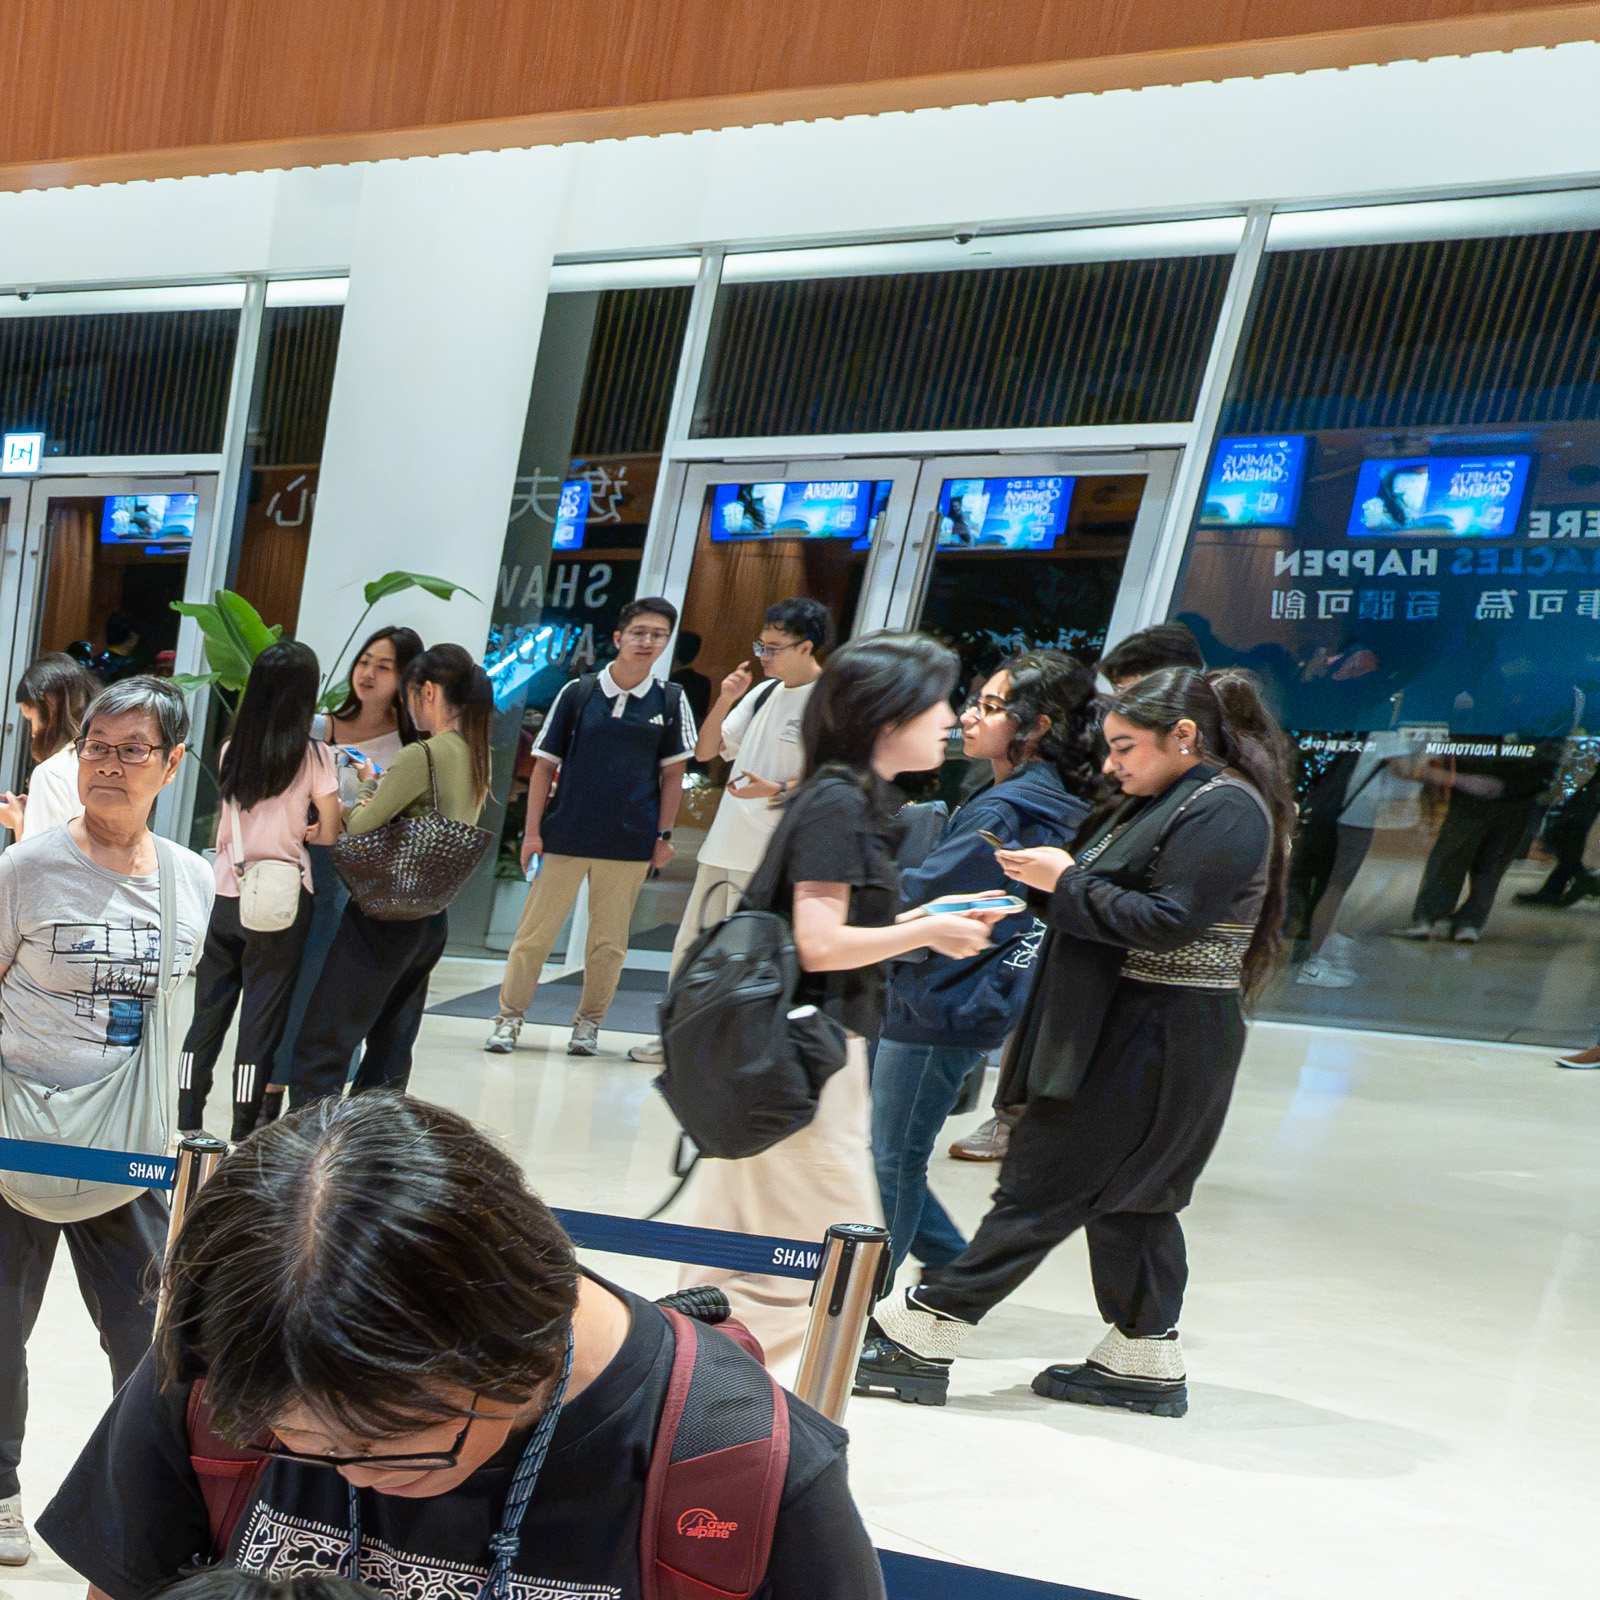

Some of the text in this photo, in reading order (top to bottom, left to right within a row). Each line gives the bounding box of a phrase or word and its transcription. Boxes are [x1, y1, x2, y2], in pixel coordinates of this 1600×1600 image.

[129, 1162, 166, 1180] SHAW
[772, 1247, 821, 1269] SHAW
[686, 1527, 730, 1539] alpine
